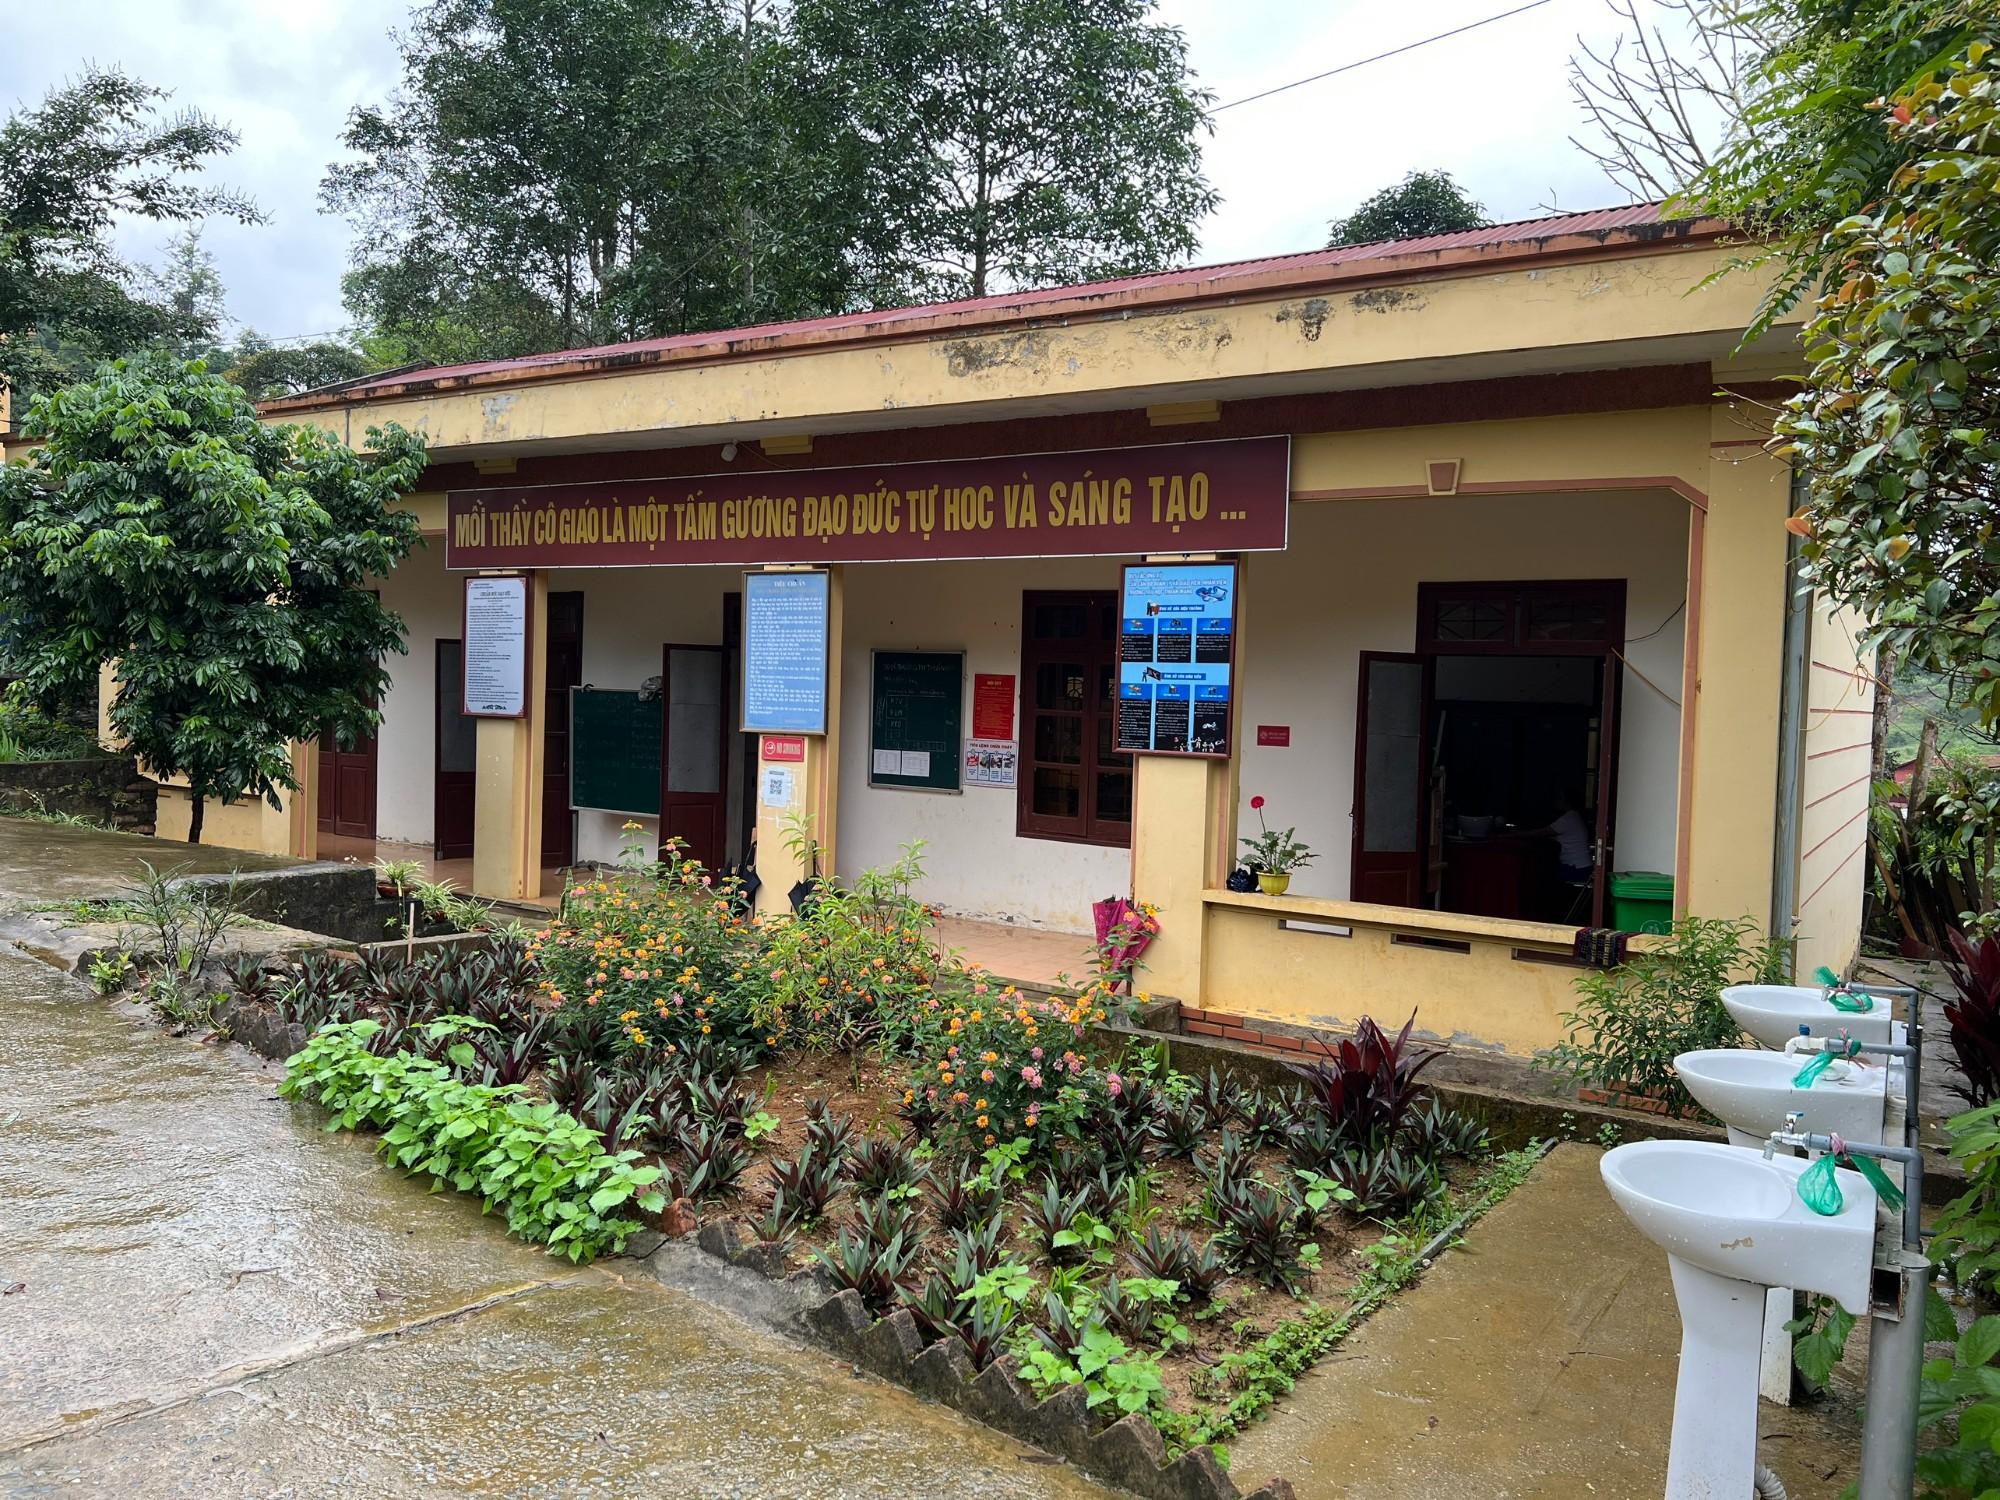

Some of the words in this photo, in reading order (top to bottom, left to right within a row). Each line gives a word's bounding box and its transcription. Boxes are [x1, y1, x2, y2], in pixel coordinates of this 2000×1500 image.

[490, 498, 532, 547] THẦY
[534, 501, 556, 545] CÔ
[559, 498, 600, 544] GIÁO
[602, 497, 626, 543] LÀ
[629, 496, 669, 551] MỘT
[674, 489, 717, 541] TẤM
[721, 495, 797, 539] GƯƠNG
[803, 494, 848, 543] ĐẠO
[852, 479, 900, 535] ĐỨC
[906, 484, 939, 541] TỰ
[1003, 471, 1038, 529] VÀ
[1048, 470, 1132, 527] SÁNG
[1148, 472, 1209, 533] TẠO
